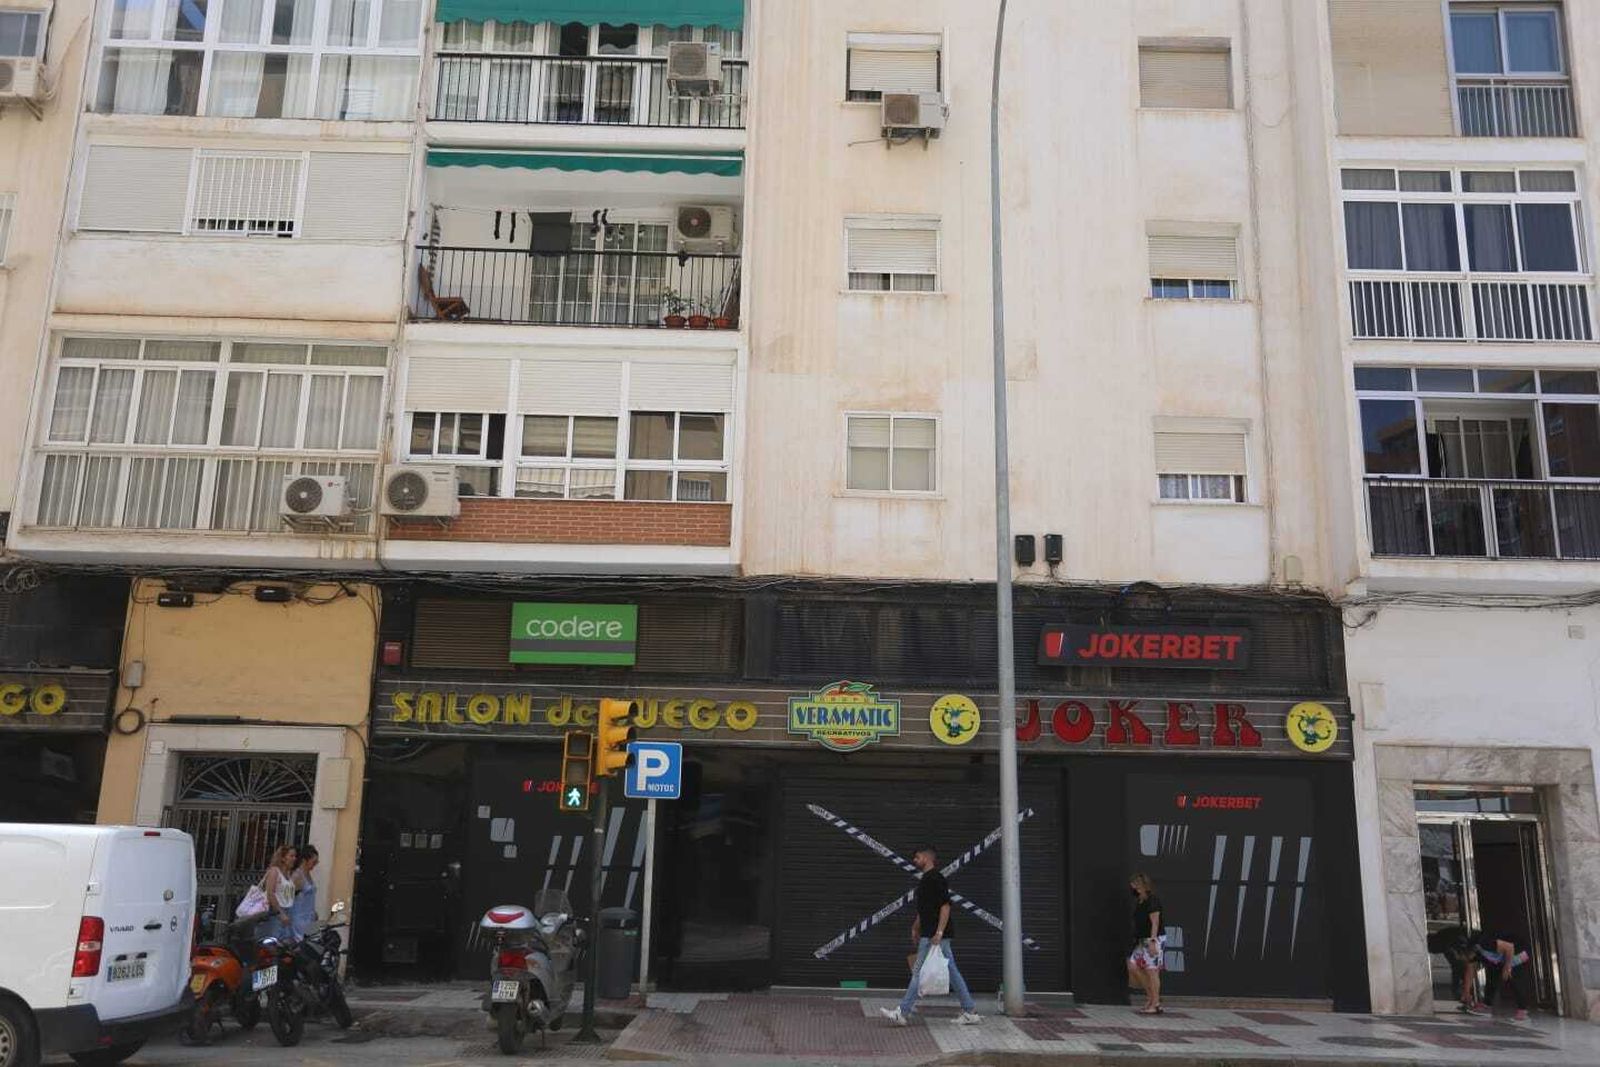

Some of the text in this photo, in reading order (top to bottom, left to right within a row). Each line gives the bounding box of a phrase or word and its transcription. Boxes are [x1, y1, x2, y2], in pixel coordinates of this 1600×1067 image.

[526, 615, 623, 638] codere
[1078, 632, 1243, 660] JOKERBET
[393, 691, 758, 731] SALON de UEGO
[795, 706, 892, 727] VERAMATIC
[816, 729, 871, 737] RECREATIVOS
[1016, 698, 1264, 748] JOKER
[636, 748, 670, 791] P
[647, 784, 674, 793] MOTOS
[1192, 795, 1263, 809] JOKERBET
